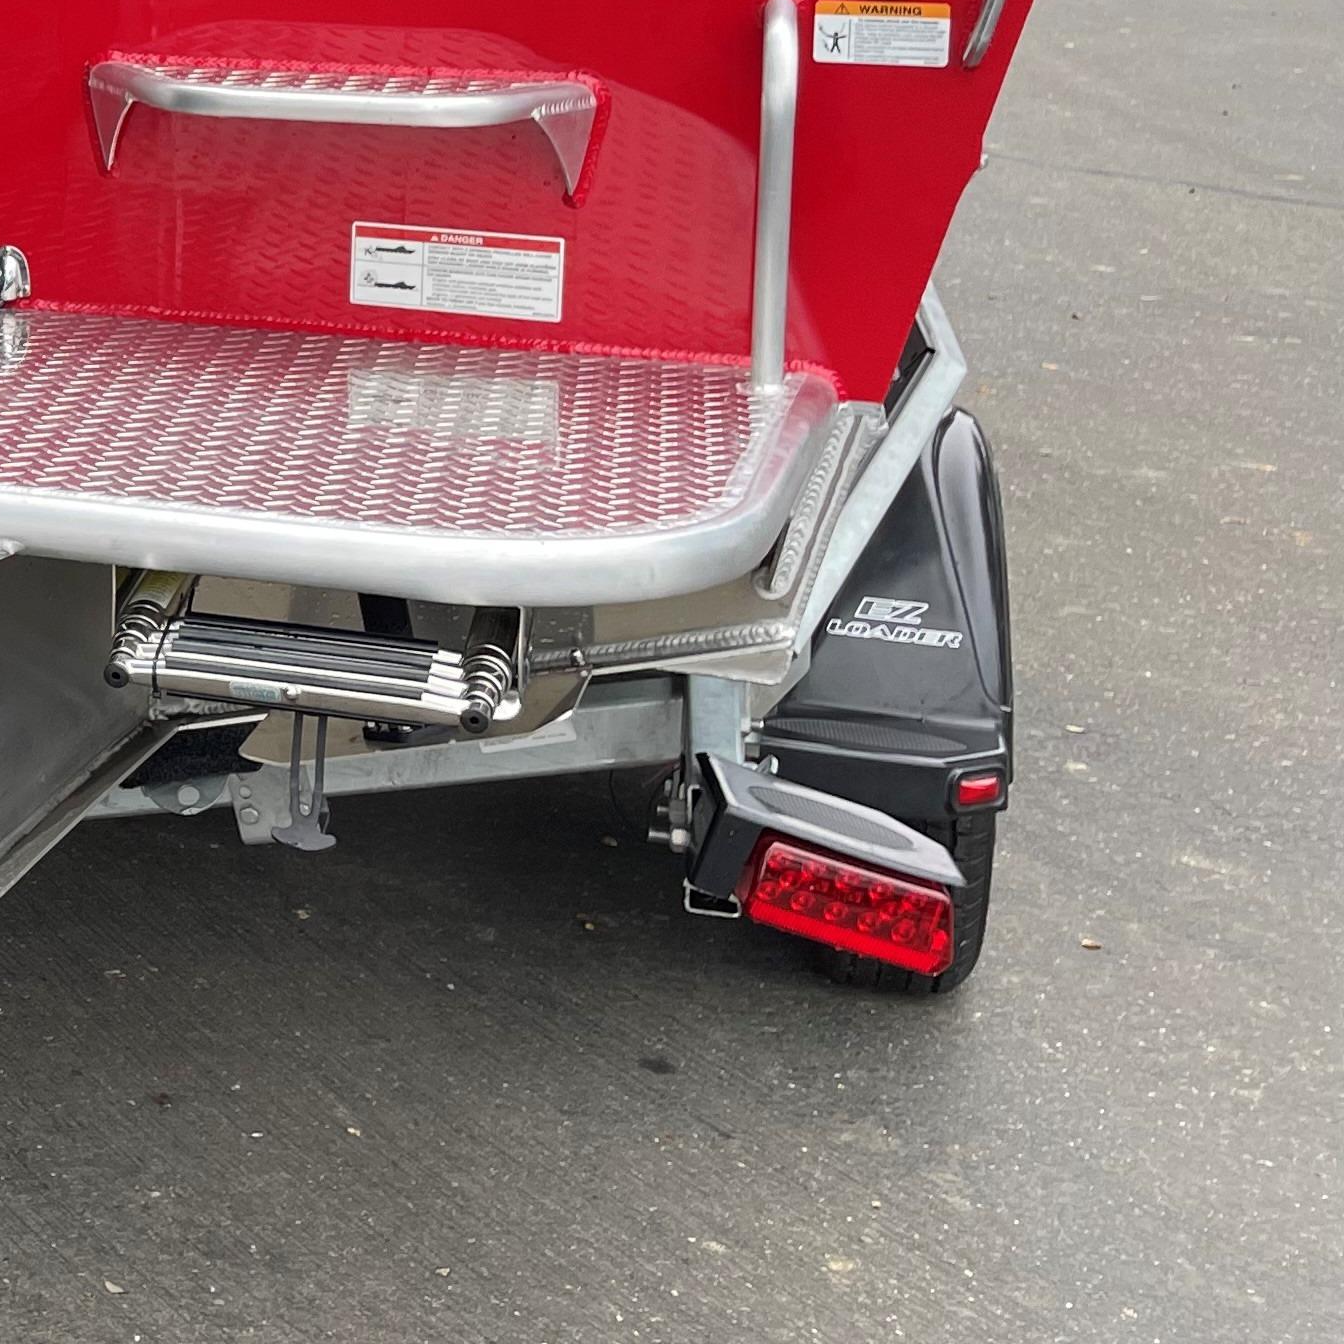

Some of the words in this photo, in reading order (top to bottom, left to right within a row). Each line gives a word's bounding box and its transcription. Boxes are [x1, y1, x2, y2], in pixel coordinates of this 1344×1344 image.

[859, 4, 922, 17] WARNING
[440, 234, 484, 246] DANGER
[854, 596, 930, 625] EZ
[825, 618, 963, 649] LOADER
